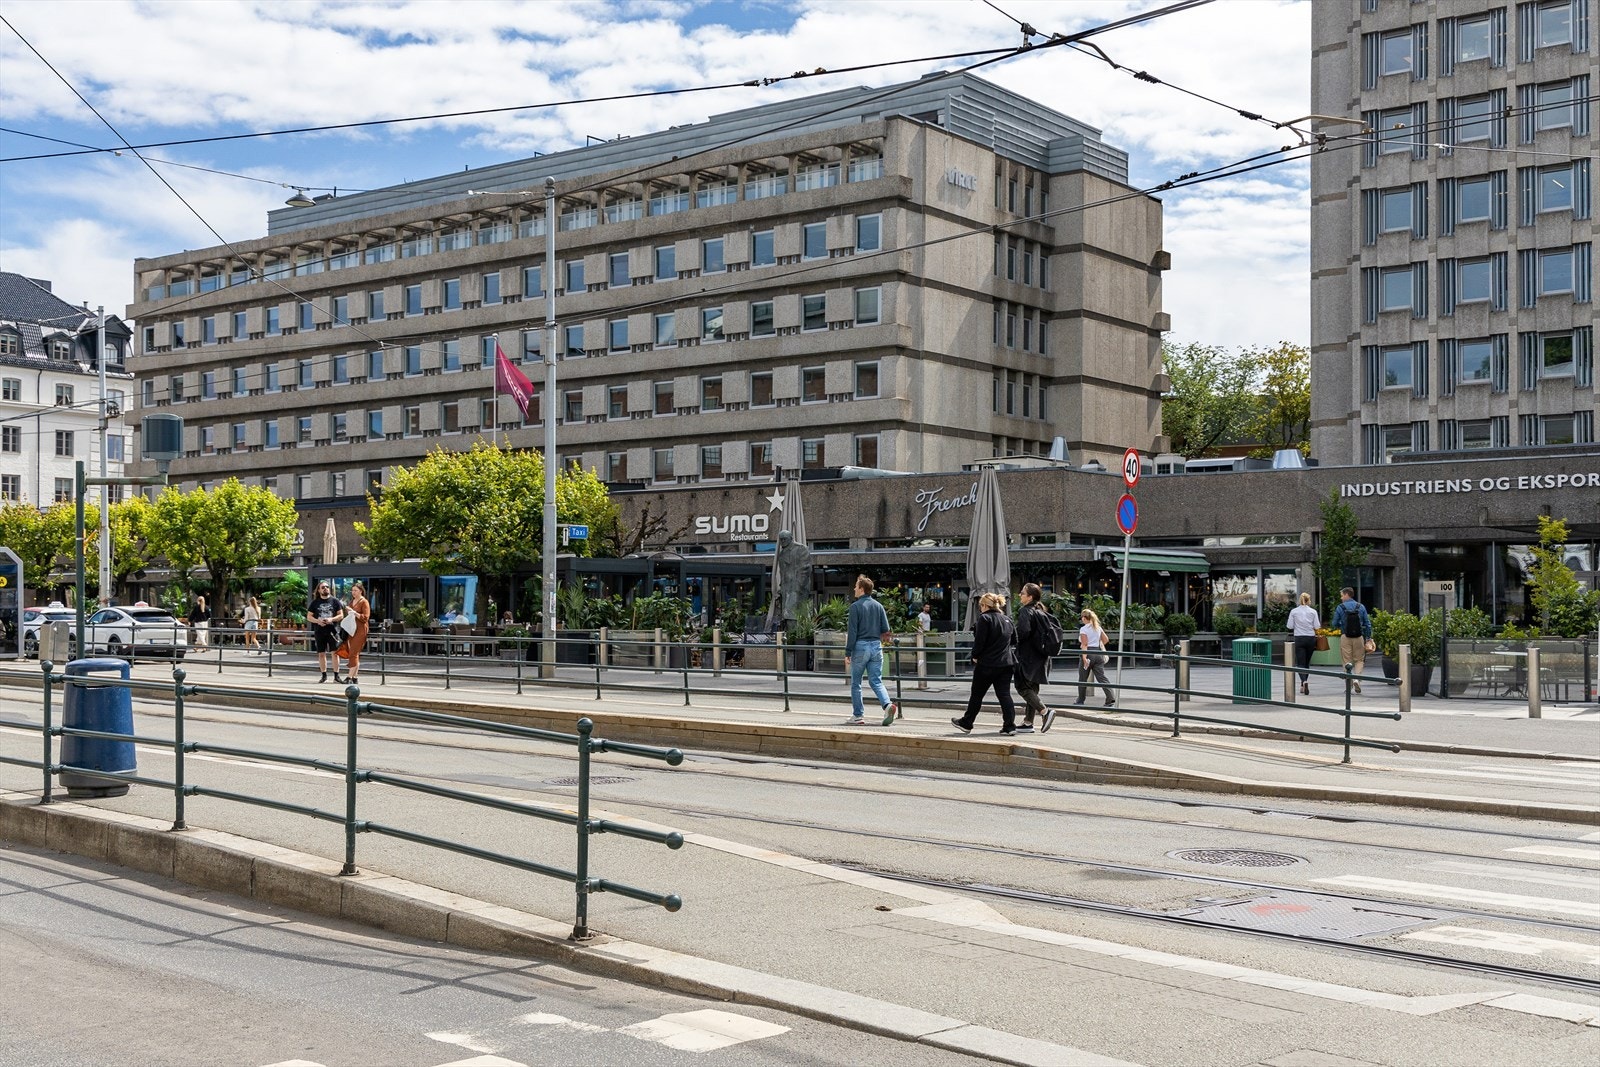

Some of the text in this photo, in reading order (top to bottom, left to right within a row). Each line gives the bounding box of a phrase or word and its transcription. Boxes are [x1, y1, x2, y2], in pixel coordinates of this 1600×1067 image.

[1126, 458, 1137, 478] 40
[1341, 472, 1600, 497] INDUSTRIENS OG EKSPOR
[695, 513, 769, 535] SUMO
[572, 527, 586, 536] Taxi
[730, 533, 769, 541] Restaurants
[1440, 583, 1453, 591] 100
